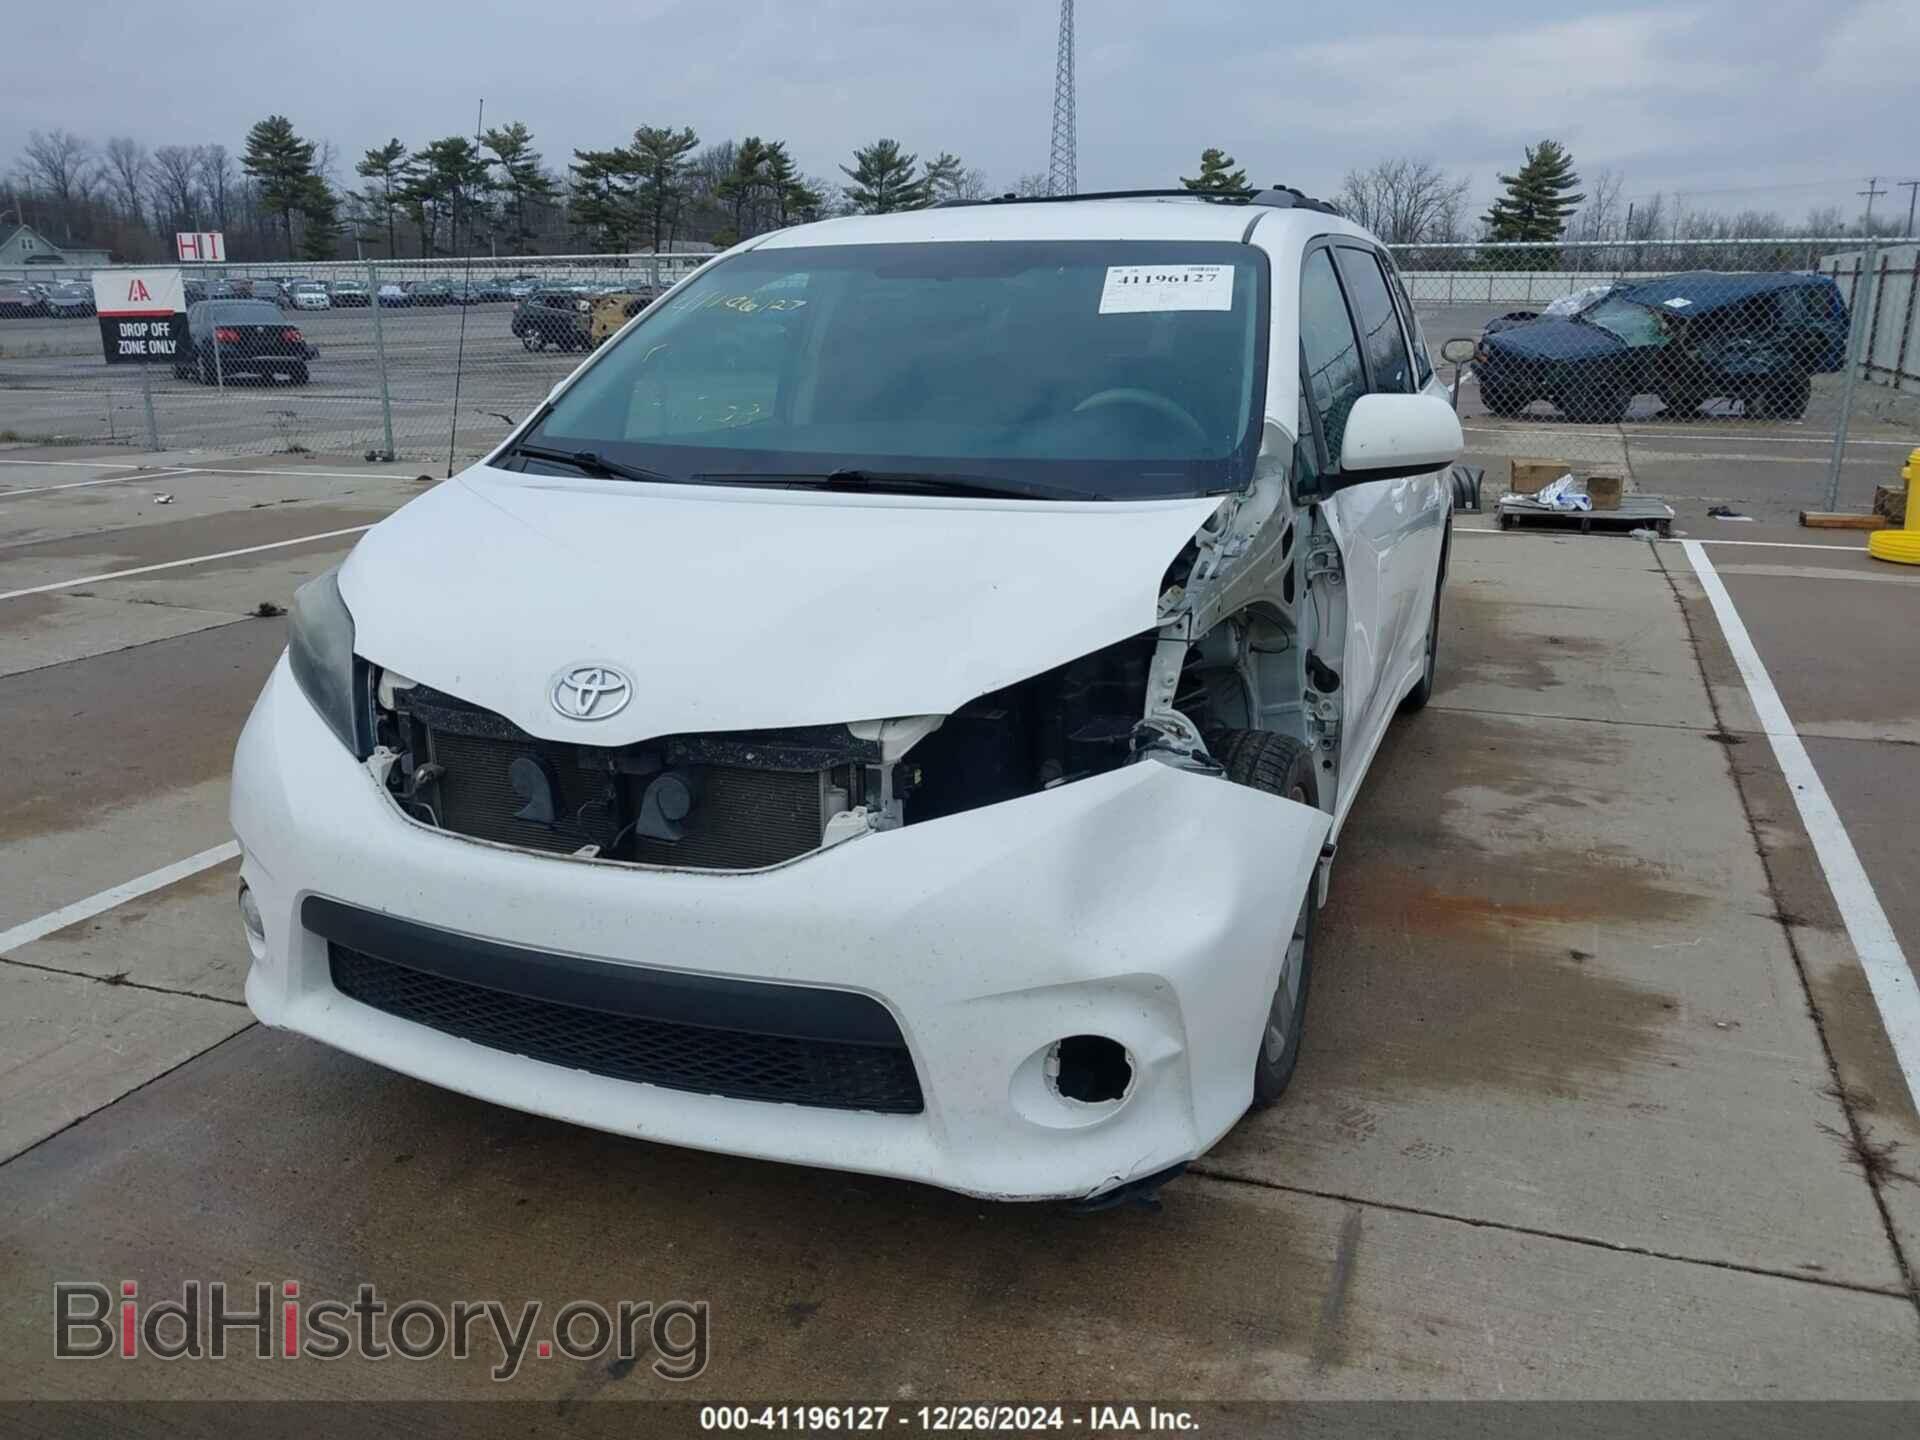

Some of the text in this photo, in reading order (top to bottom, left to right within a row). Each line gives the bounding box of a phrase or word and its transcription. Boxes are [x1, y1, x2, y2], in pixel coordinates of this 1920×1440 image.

[1117, 273, 1217, 285] 41196127
[119, 322, 170, 337] DROP OFF
[118, 341, 176, 354] ZONE ONLY
